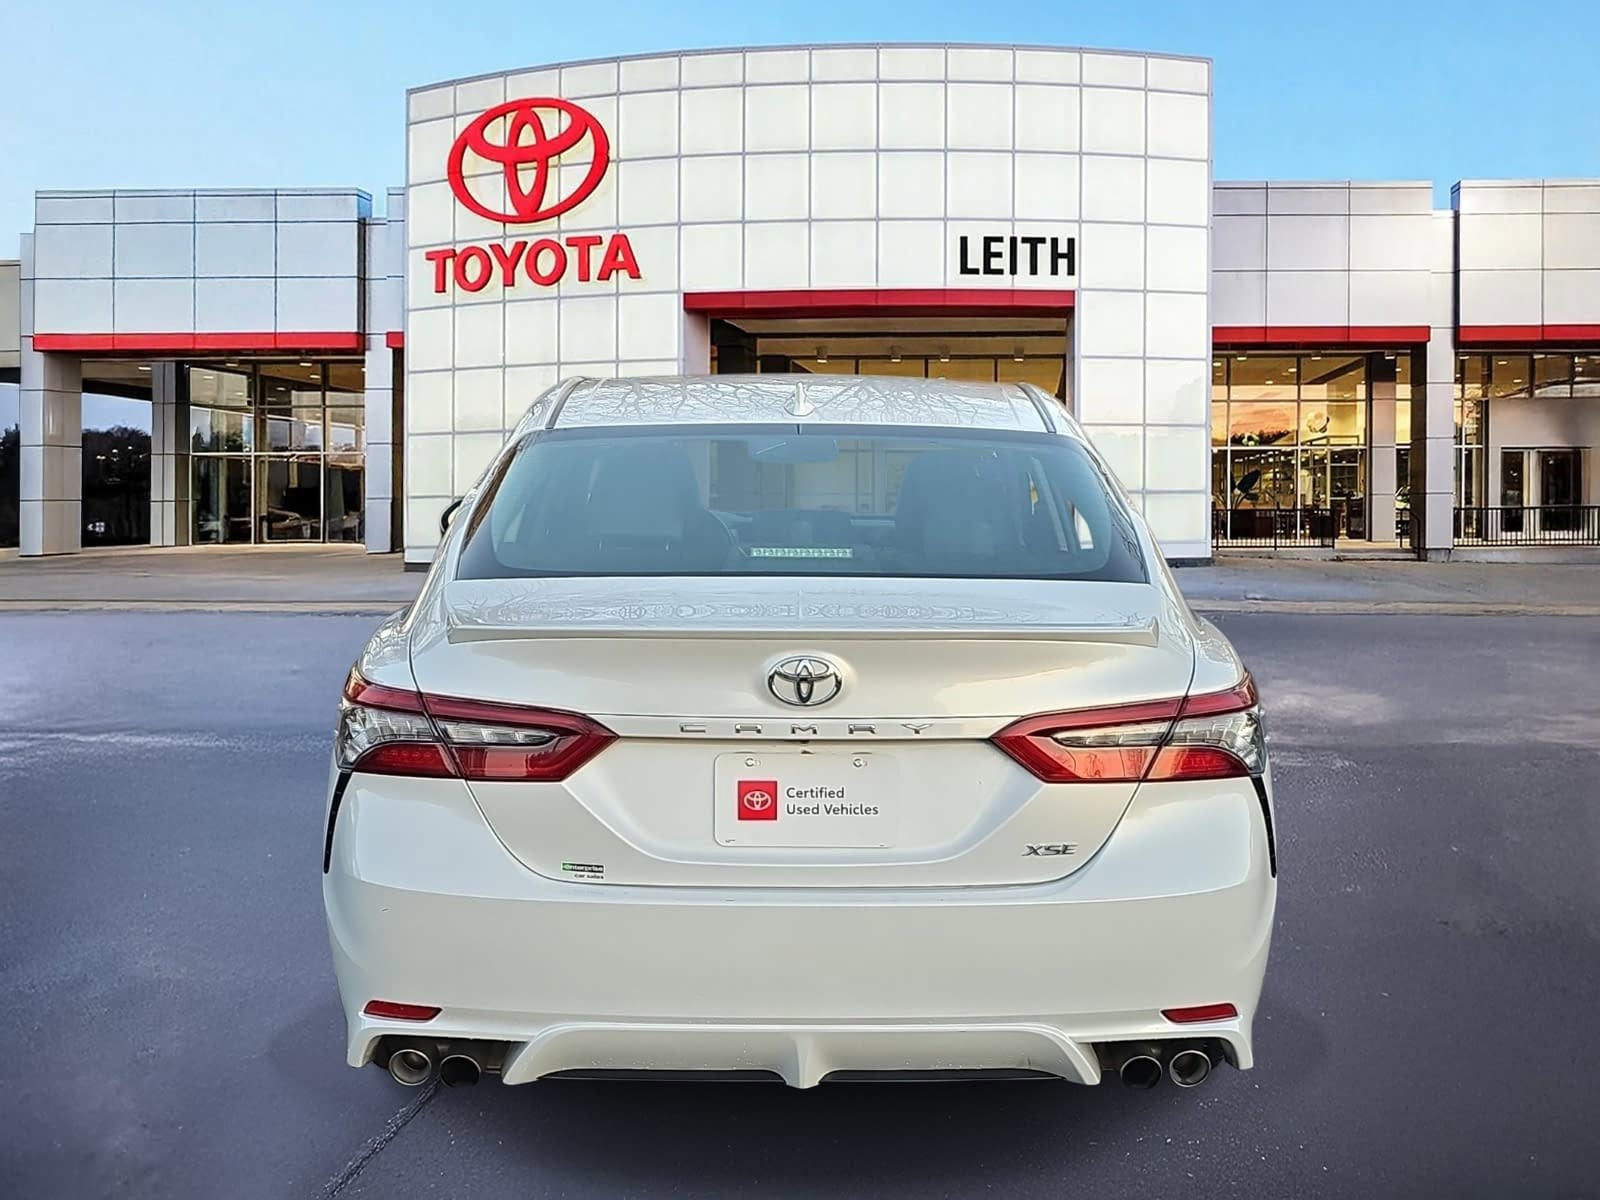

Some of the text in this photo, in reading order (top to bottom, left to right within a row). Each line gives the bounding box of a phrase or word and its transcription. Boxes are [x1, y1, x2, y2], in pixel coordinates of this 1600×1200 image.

[960, 236, 1076, 276] LEITH
[425, 234, 642, 293] TOYOTA
[680, 723, 934, 735] CAMRY
[786, 786, 845, 799] Certified
[786, 803, 880, 816] Used Vehicles
[1021, 844, 1078, 857] XSE
